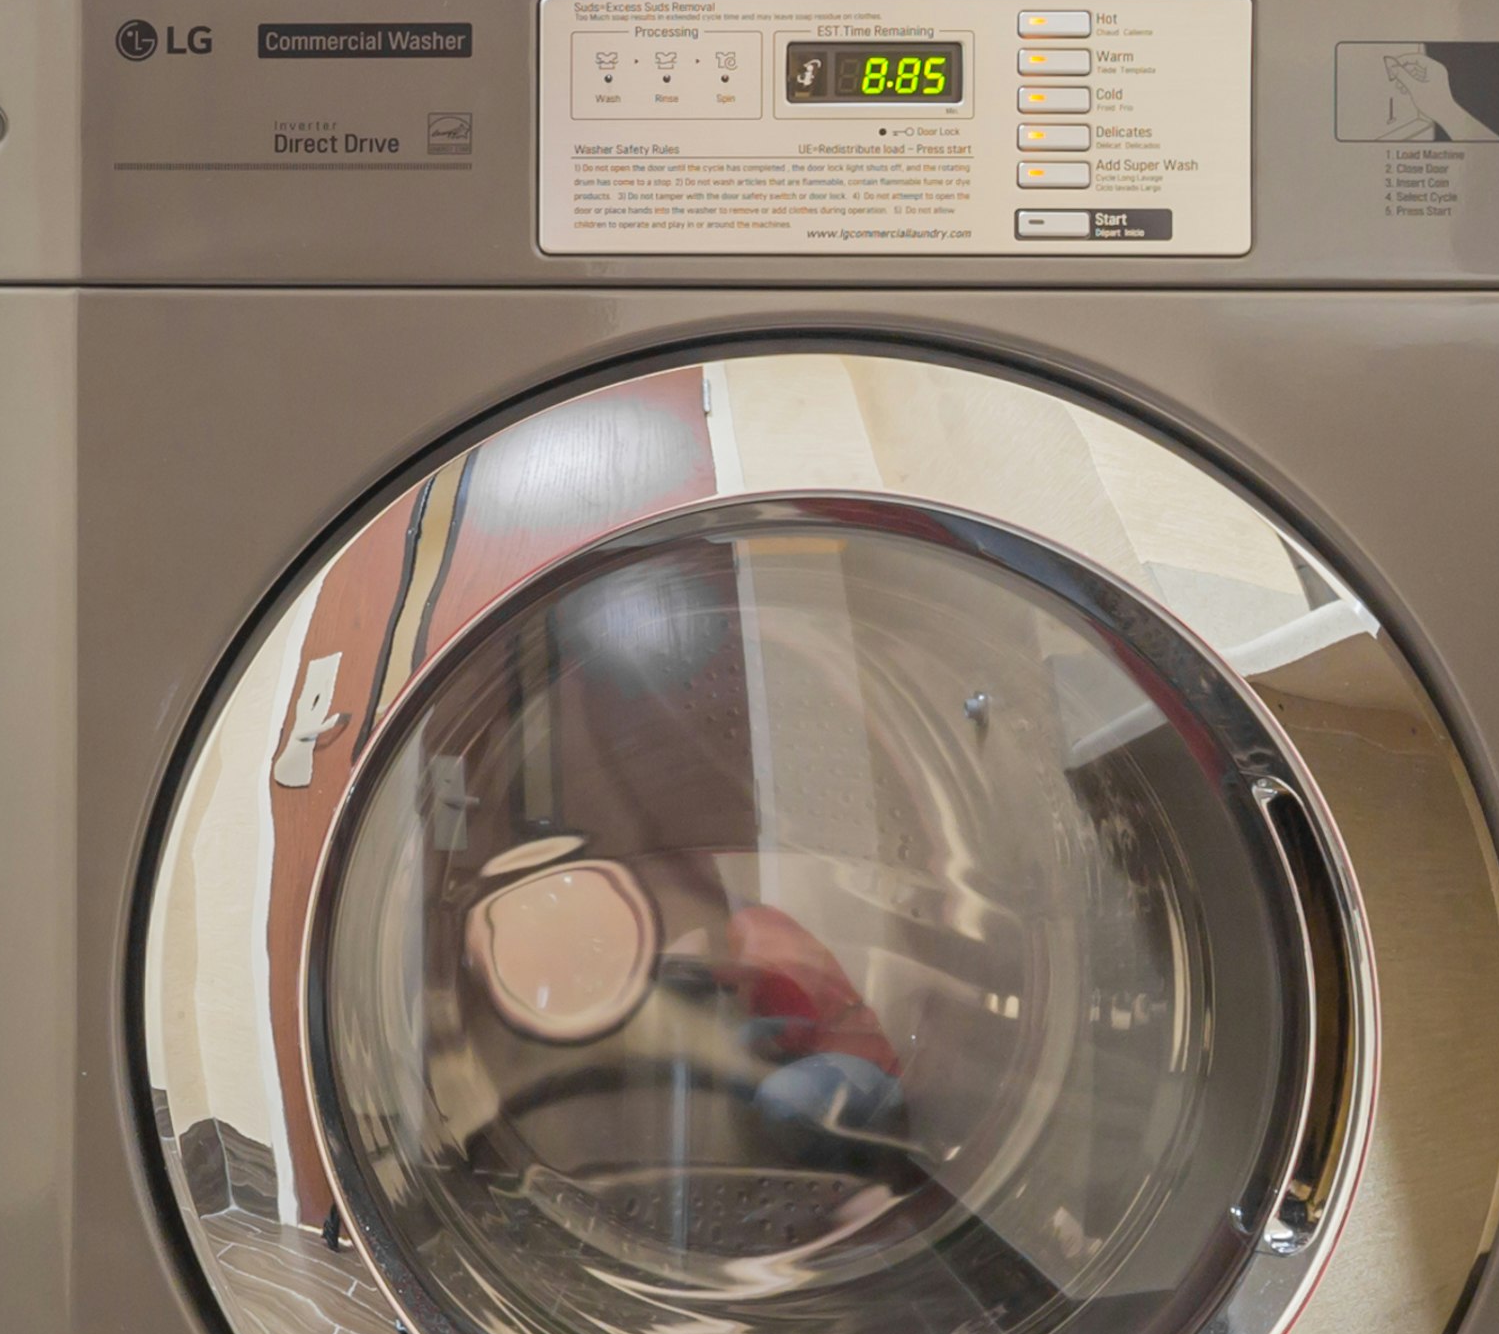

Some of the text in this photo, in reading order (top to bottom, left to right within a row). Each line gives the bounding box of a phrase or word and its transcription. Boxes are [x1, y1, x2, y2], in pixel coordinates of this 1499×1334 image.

[645, 2, 670, 12] Suds
[672, 2, 716, 12] Removal
[1096, 13, 1117, 25] Hot
[635, 26, 698, 39] Processing
[874, 25, 934, 38] Remaining
[166, 25, 213, 55] LG
[265, 30, 466, 52] Commercial Washer
[1096, 51, 1134, 62] Warm
[862, 57, 946, 94] 8.85
[595, 94, 621, 103] Wash
[655, 94, 679, 103] Rinse
[716, 94, 736, 105] Spin
[1096, 88, 1123, 100] Cold
[274, 120, 338, 131] Inverter
[918, 128, 960, 136] Door Lock
[1096, 126, 1152, 138] Delicates
[274, 133, 399, 154] Direct Drive
[884, 144, 905, 154] load
[916, 145, 945, 154] Press
[947, 144, 971, 154] start
[574, 144, 680, 157] Washer Safety Rules
[1096, 159, 1199, 172] Add Super Wash
[1095, 213, 1127, 226] Start
